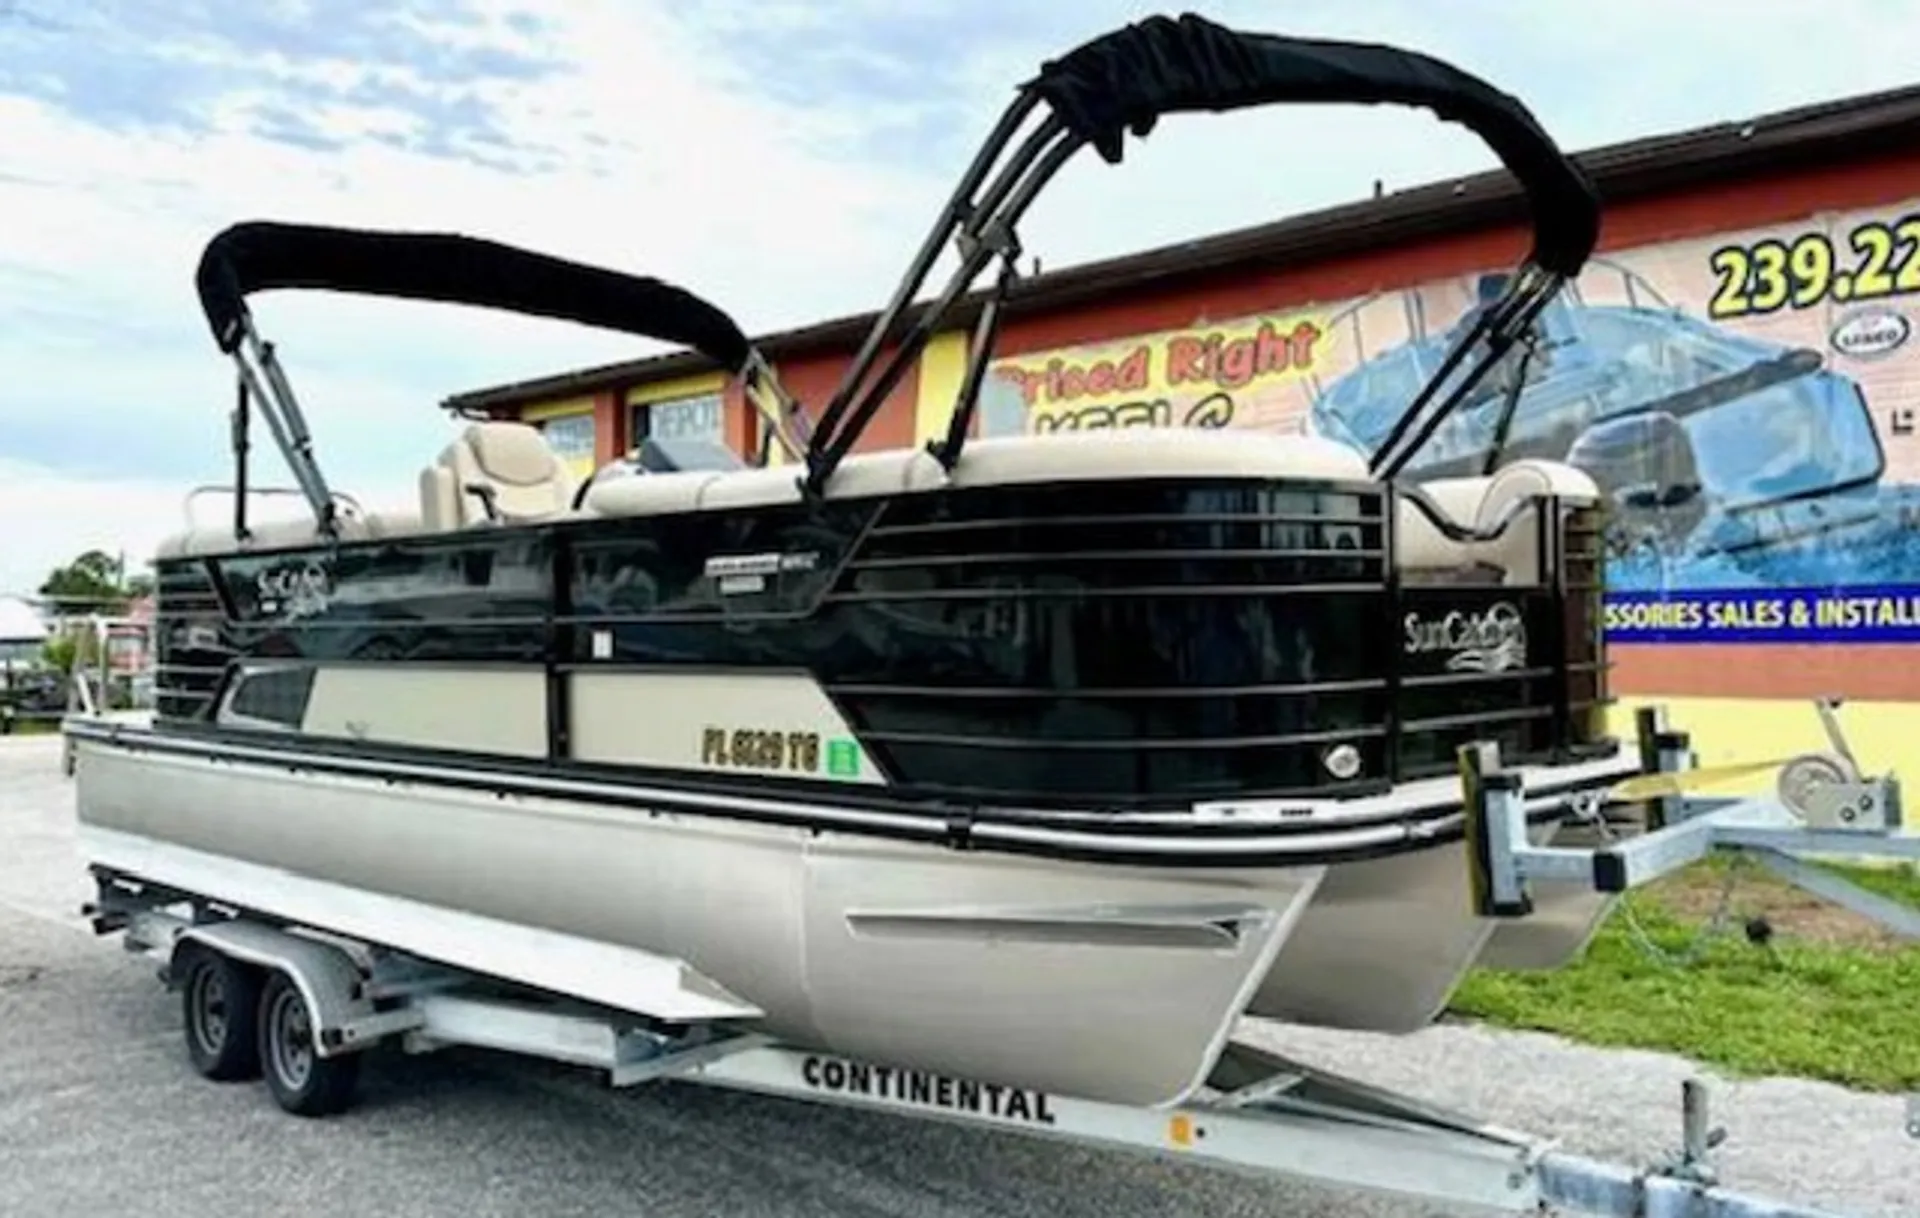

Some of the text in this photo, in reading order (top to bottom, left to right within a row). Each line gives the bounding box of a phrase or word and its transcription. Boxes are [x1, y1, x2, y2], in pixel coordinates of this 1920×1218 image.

[1708, 211, 1920, 320] 239.22
[1166, 319, 1320, 388] Right
[1604, 602, 1702, 631] SSORIES
[1707, 601, 1785, 628] SALES
[1790, 600, 1811, 628] &
[802, 1056, 1055, 1125] CONTINENTAL
